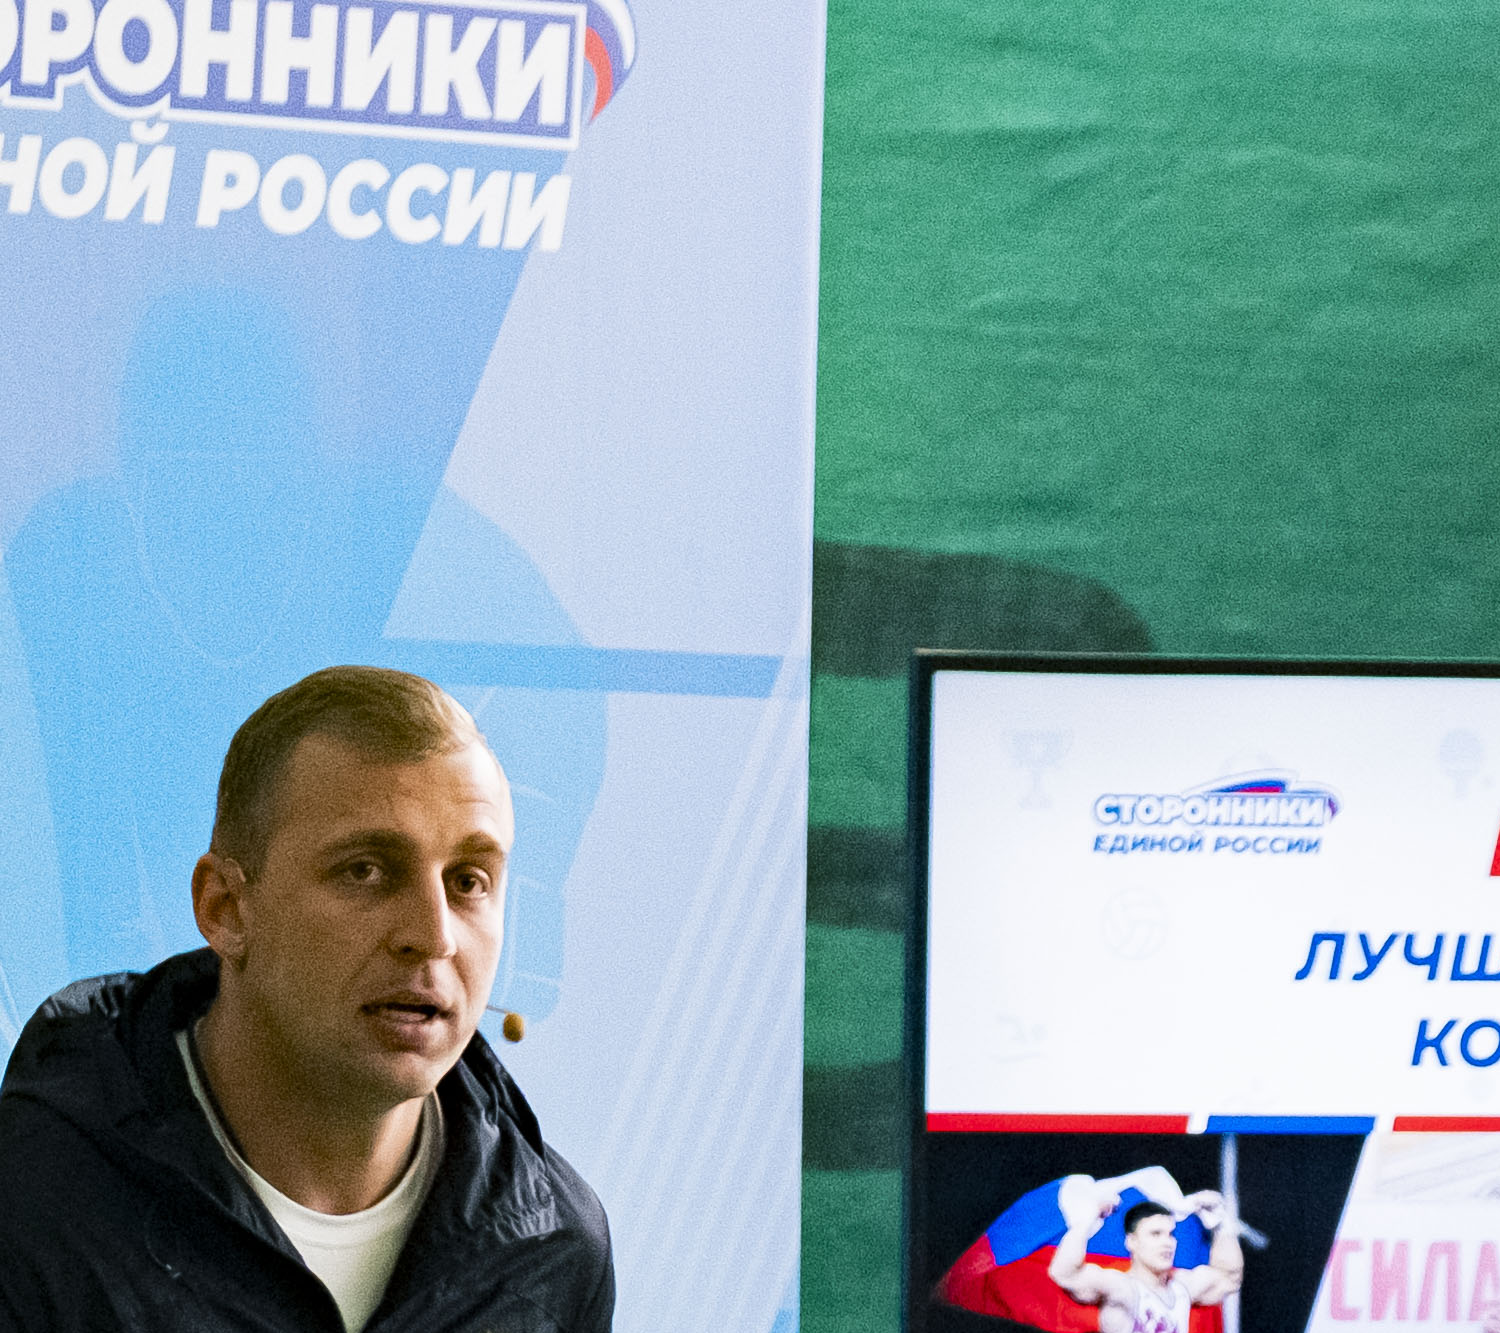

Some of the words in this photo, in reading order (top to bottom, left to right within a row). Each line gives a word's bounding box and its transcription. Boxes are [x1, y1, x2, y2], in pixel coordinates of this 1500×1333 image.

[195, 148, 573, 252] РОССИИ
[1095, 795, 1324, 825] СТОРОННИКИ
[1093, 830, 1204, 854] ЕДИНОЙ
[1213, 835, 1323, 854] РОССИИ
